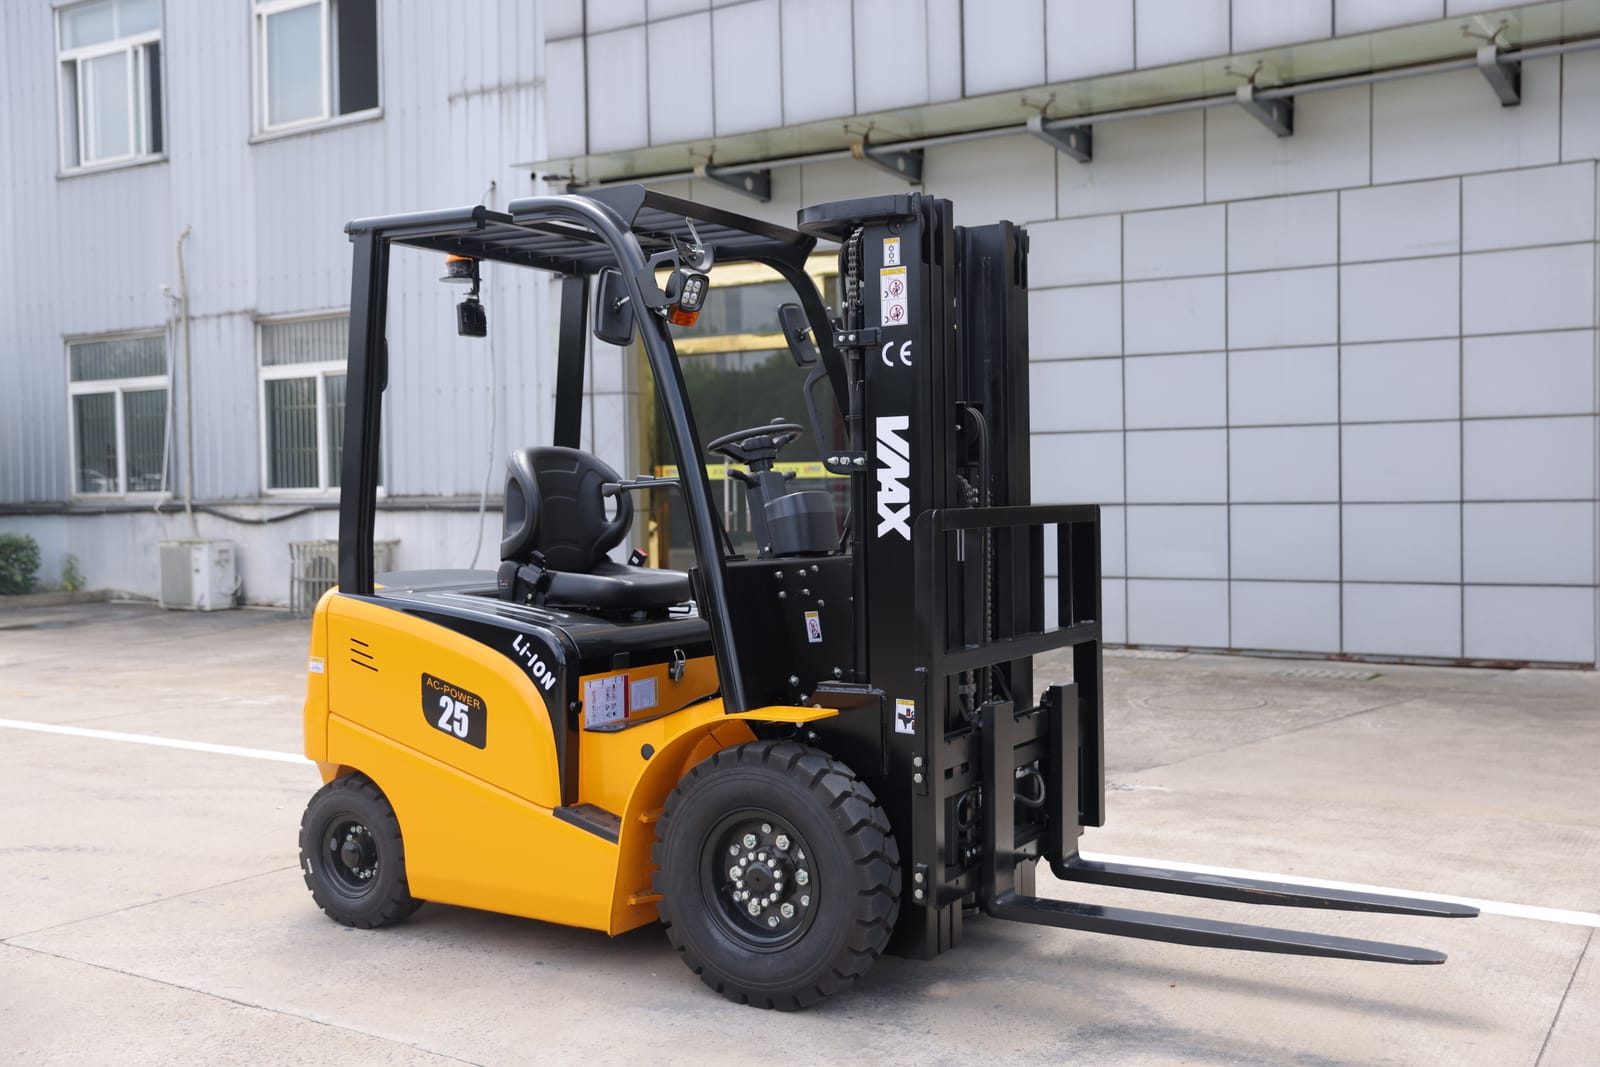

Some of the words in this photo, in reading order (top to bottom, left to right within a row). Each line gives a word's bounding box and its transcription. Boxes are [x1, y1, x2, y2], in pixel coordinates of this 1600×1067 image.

[882, 340, 912, 367] CE
[876, 415, 911, 541] VMAX
[512, 634, 556, 690] Li-ION
[426, 677, 480, 709] AC-POWER
[438, 695, 469, 738] 25
